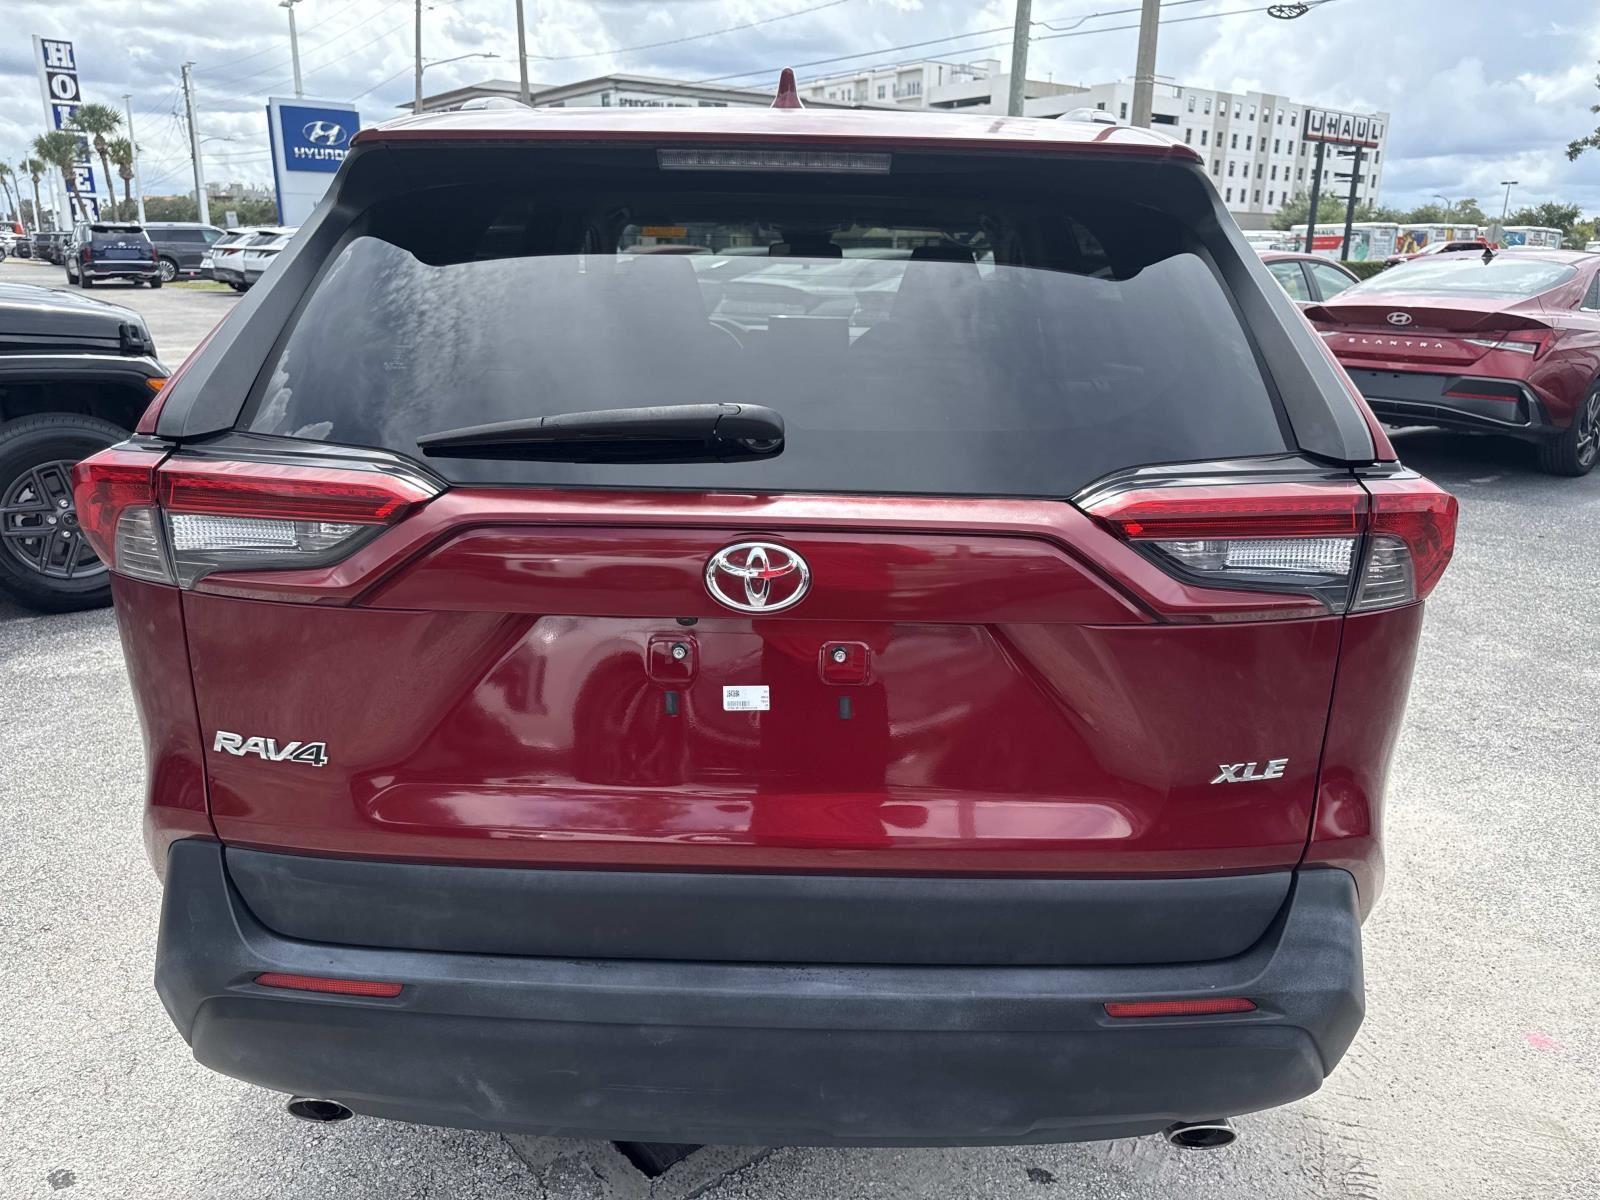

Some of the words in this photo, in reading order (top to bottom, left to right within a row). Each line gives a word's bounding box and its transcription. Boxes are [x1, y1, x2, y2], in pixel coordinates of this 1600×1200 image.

[1348, 337, 1443, 349] ELANTRA
[213, 730, 328, 768] RAV4
[1210, 758, 1289, 785] XLE
